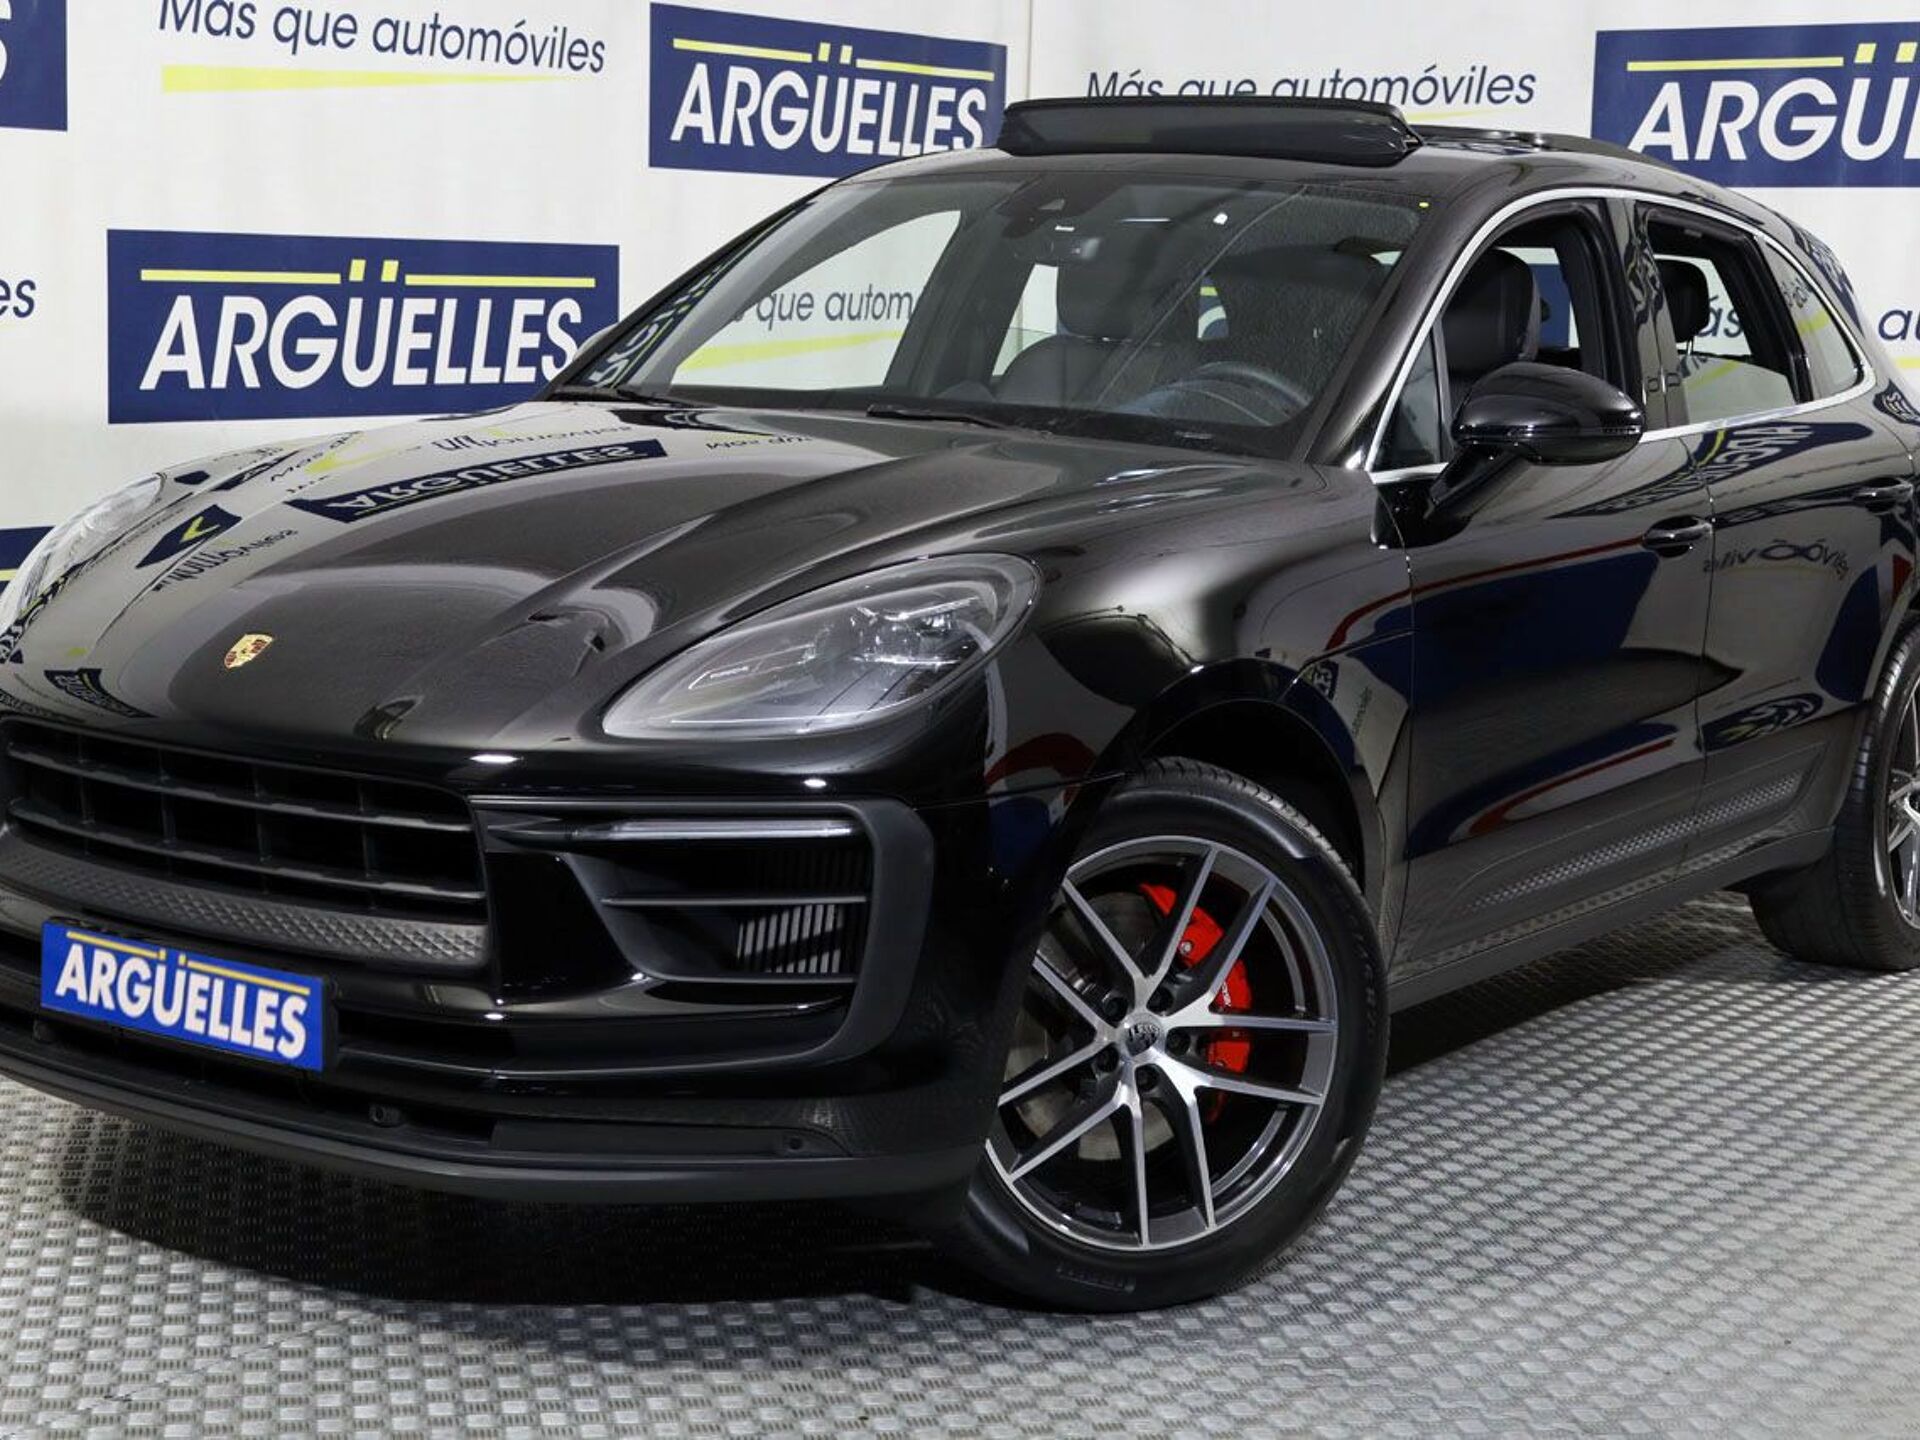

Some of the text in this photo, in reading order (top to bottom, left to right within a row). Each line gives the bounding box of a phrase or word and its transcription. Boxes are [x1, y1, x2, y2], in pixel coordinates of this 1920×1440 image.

[273, 7, 358, 55] que
[372, 19, 606, 73] automóviles
[1271, 64, 1536, 106] automóviles
[670, 41, 987, 156] ARGÜELLES
[139, 258, 583, 391] ARGÜELLES
[756, 291, 814, 331] que
[55, 943, 309, 1059] ARGÜELLES
